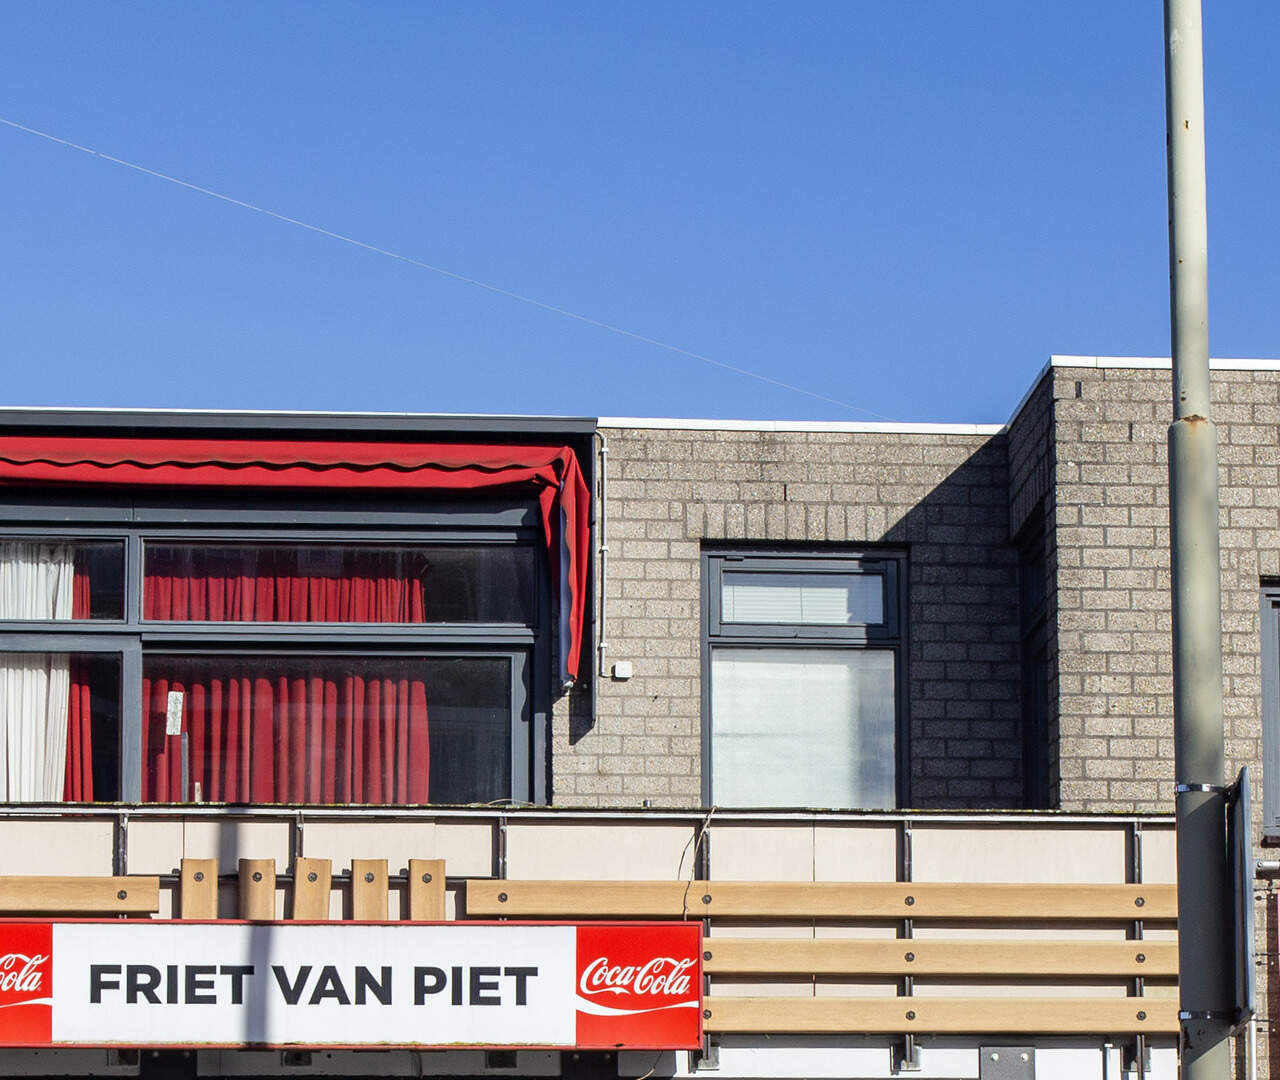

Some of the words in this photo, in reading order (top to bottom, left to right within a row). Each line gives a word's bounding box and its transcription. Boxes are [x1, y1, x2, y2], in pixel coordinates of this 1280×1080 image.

[90, 965, 256, 1005] FRIET
[272, 965, 392, 1005] VAN
[414, 966, 538, 1005] PIET
[580, 956, 698, 996] Coca-Cola
